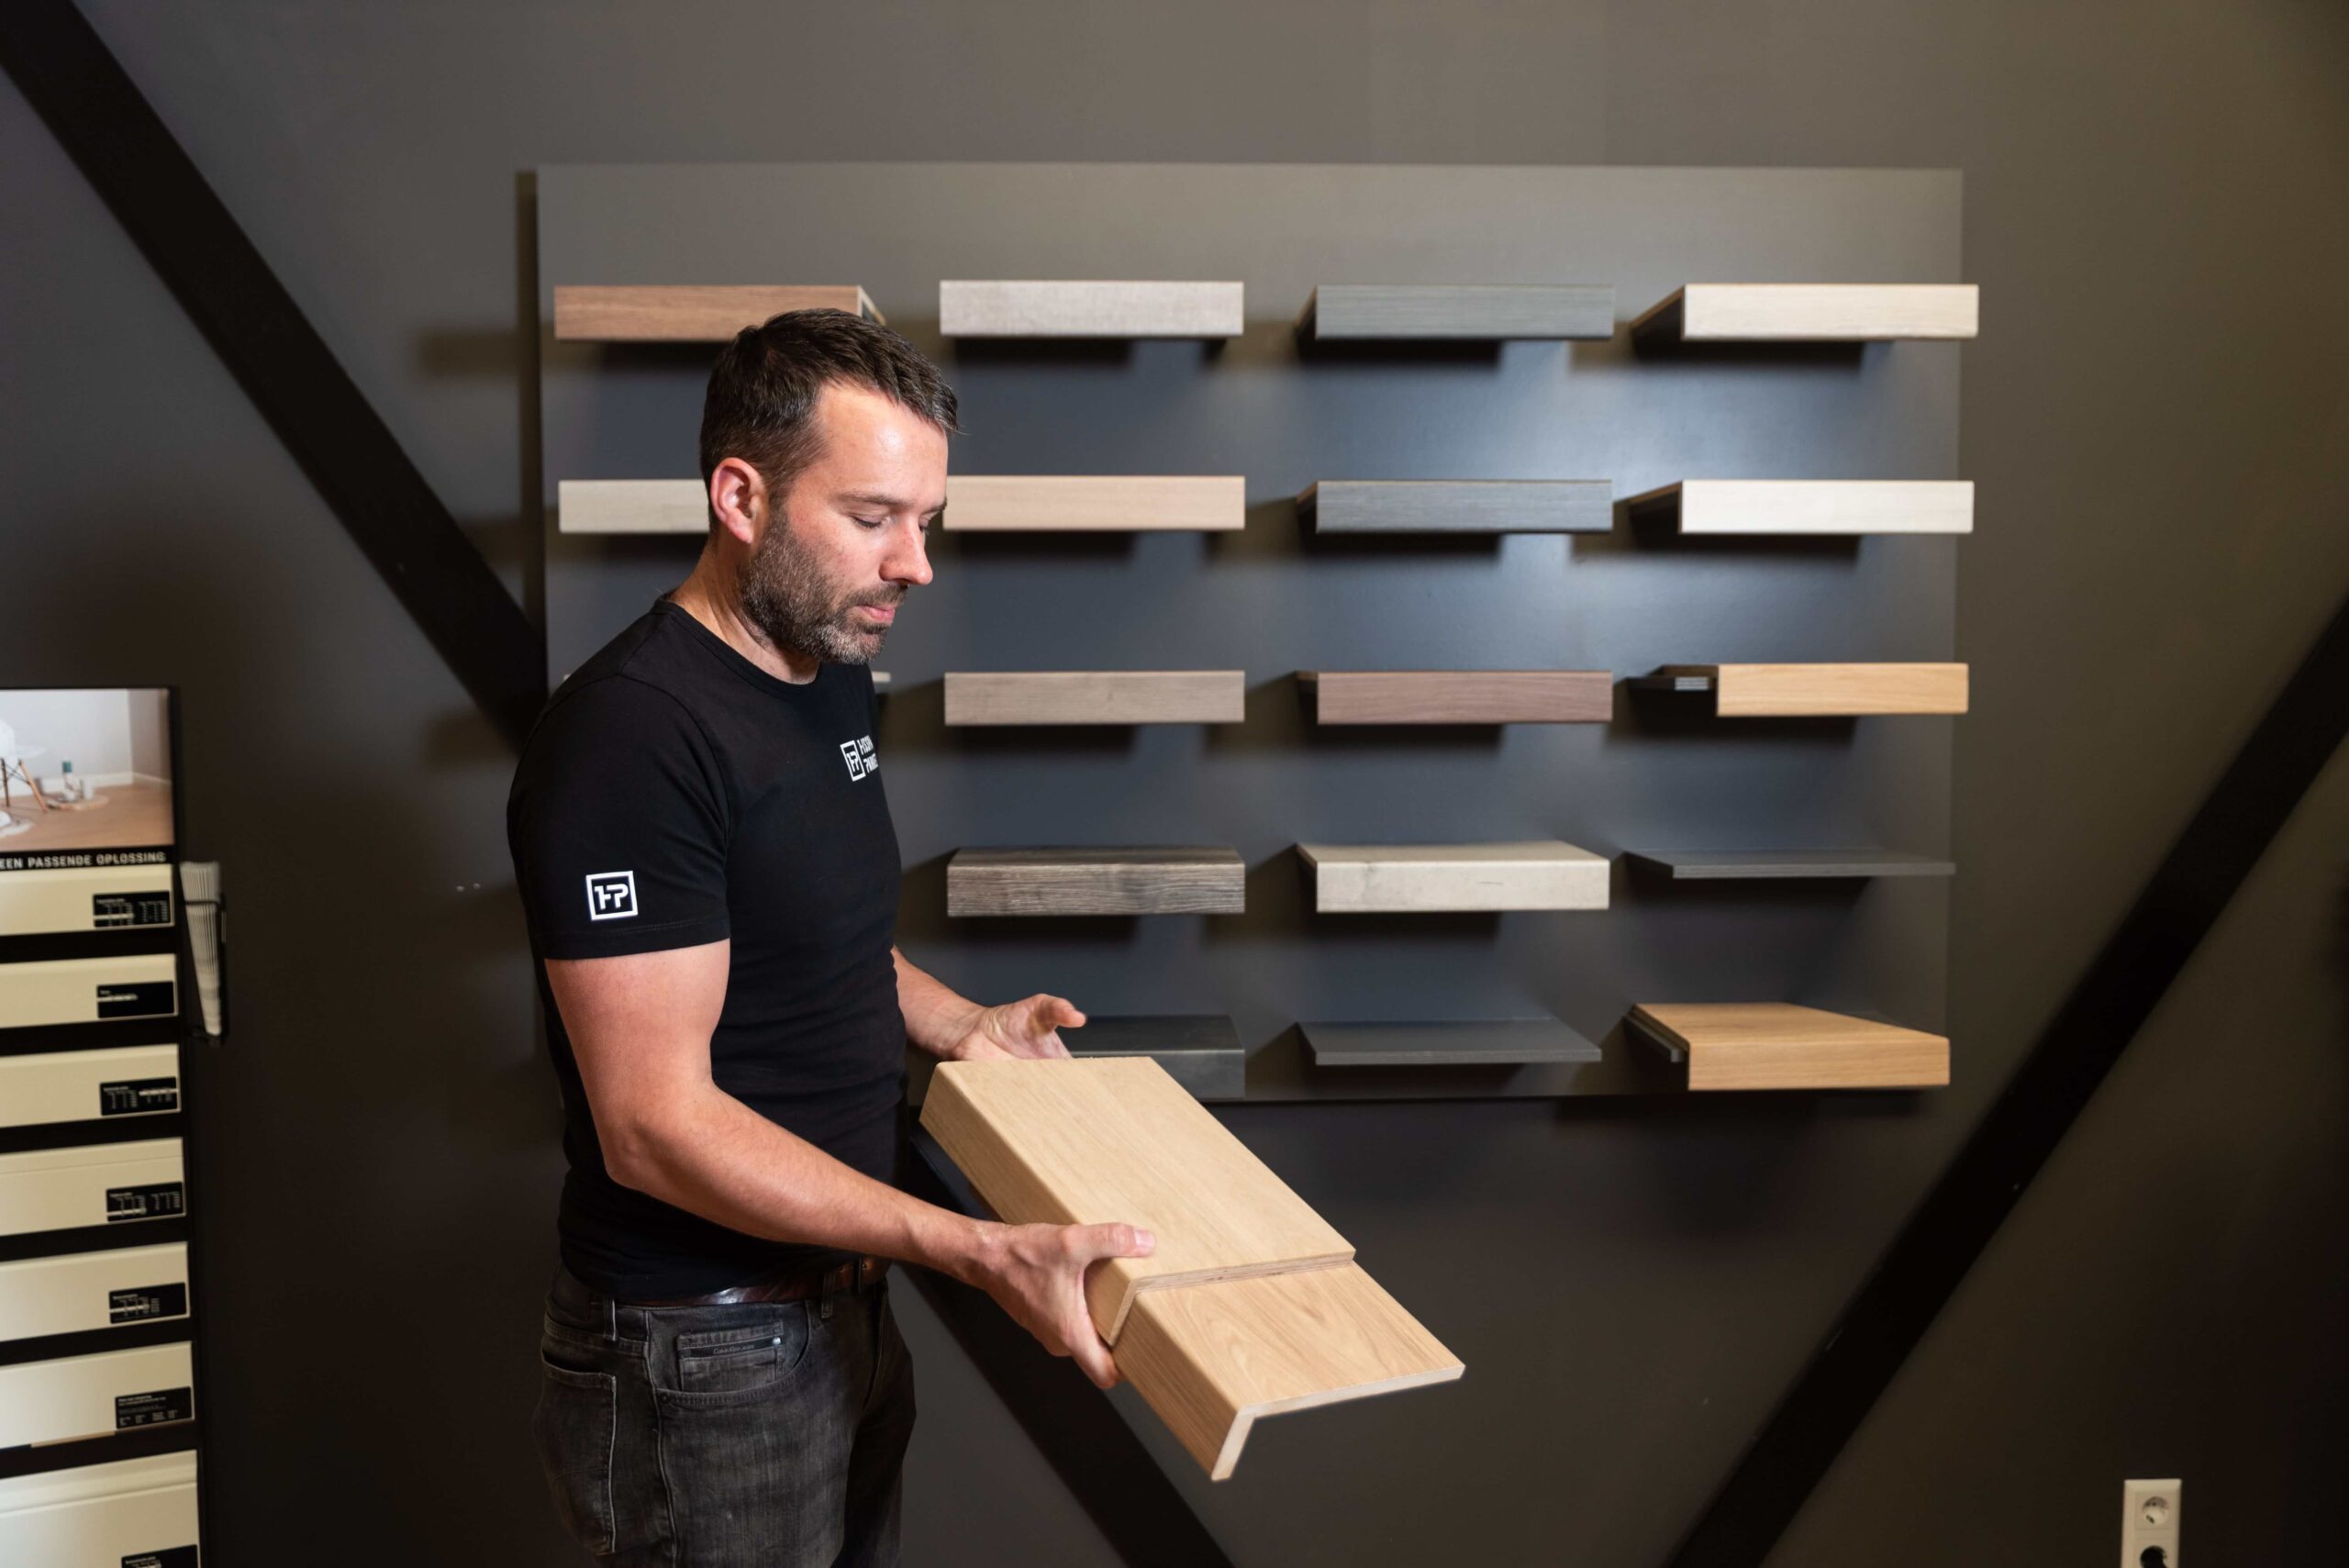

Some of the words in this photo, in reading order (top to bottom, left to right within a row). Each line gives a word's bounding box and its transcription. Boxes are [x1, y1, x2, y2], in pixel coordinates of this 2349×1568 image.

[0, 857, 23, 869] EEN
[28, 854, 91, 868] PASSENDE
[95, 851, 165, 865] OPLOSSING
